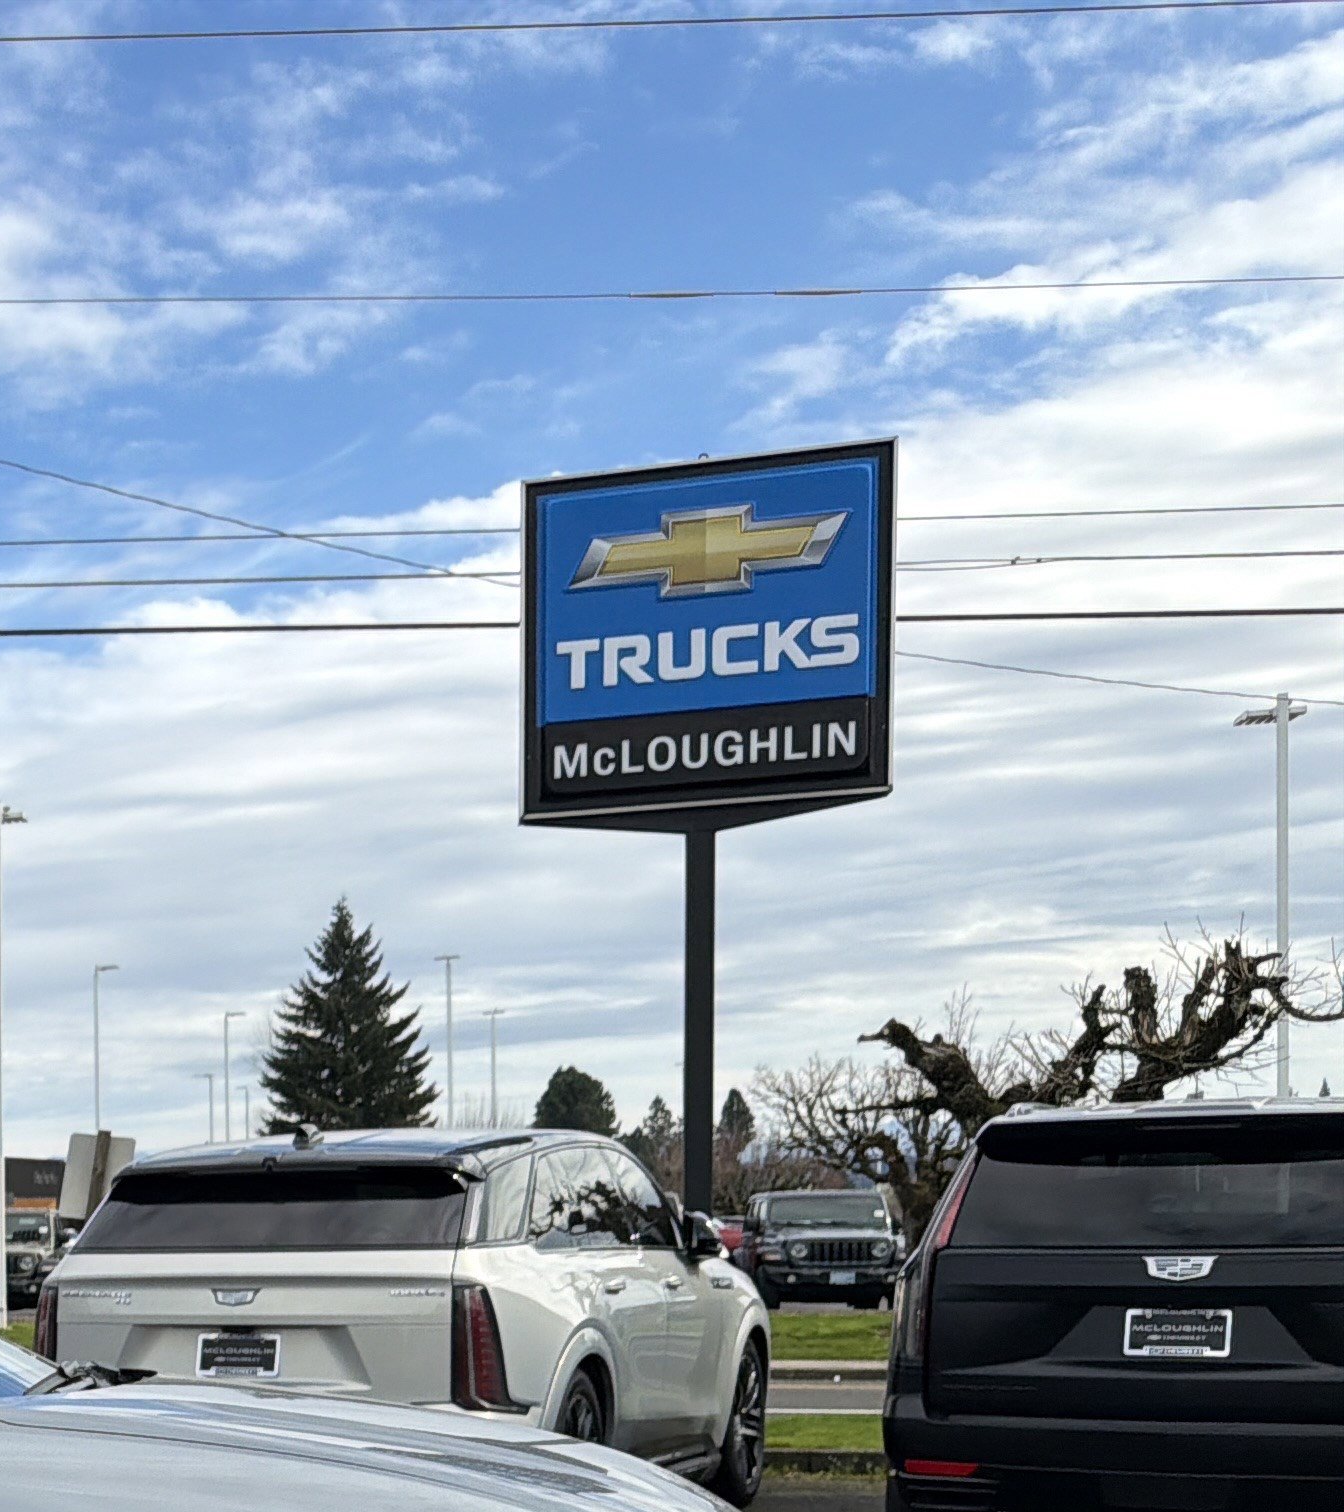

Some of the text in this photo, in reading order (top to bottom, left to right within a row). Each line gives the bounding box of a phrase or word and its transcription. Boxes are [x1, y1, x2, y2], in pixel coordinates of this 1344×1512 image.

[556, 613, 860, 690] TRUCKS
[553, 721, 857, 780] McLOUGHLIN
[1132, 1324, 1224, 1332] MCLOUGHLIN
